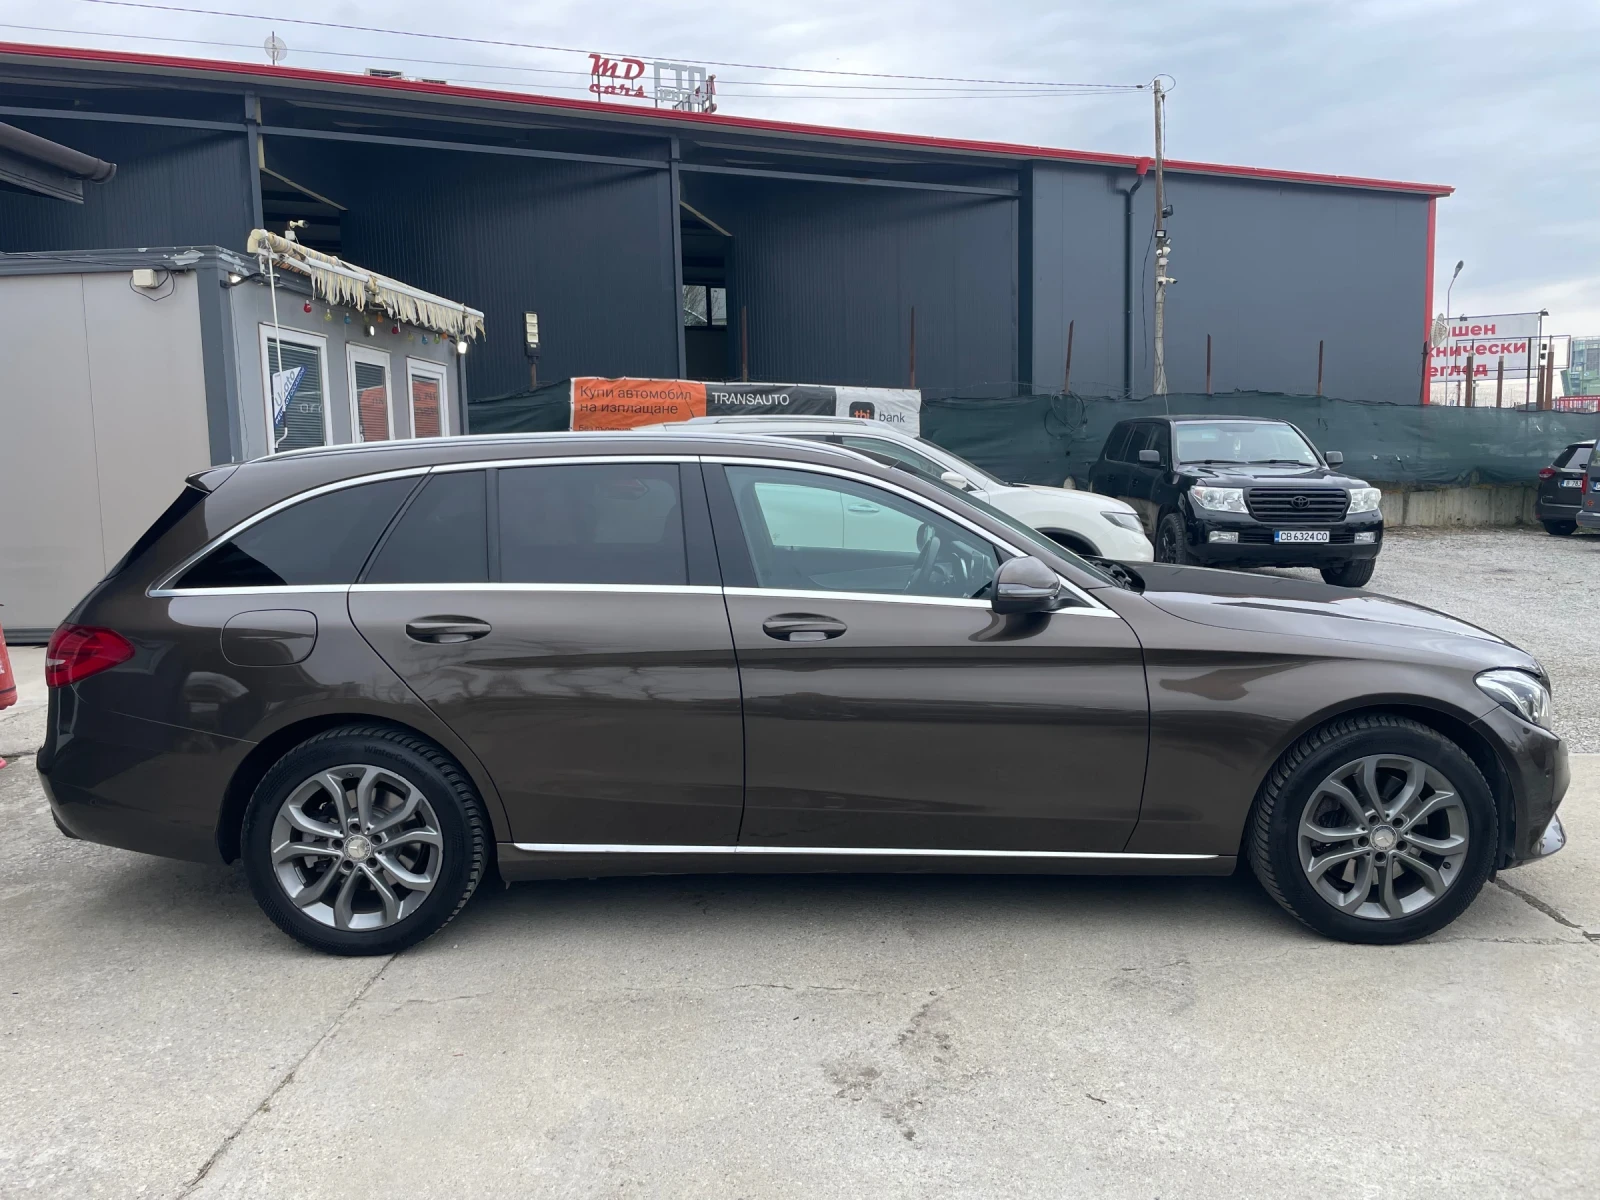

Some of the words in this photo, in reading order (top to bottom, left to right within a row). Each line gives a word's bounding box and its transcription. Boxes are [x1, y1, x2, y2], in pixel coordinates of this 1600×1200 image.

[588, 54, 645, 80] MD
[589, 83, 647, 99] cars
[1447, 323, 1496, 338] шен
[580, 385, 614, 400] Купи
[617, 388, 692, 401] автомобил
[711, 392, 790, 406] TRANSAUTO
[580, 403, 596, 413] на
[600, 405, 679, 416] изплащане
[879, 410, 906, 423] bank
[1280, 532, 1293, 541] CB
[1293, 532, 1315, 541] 6324
[1315, 532, 1328, 541] CO
